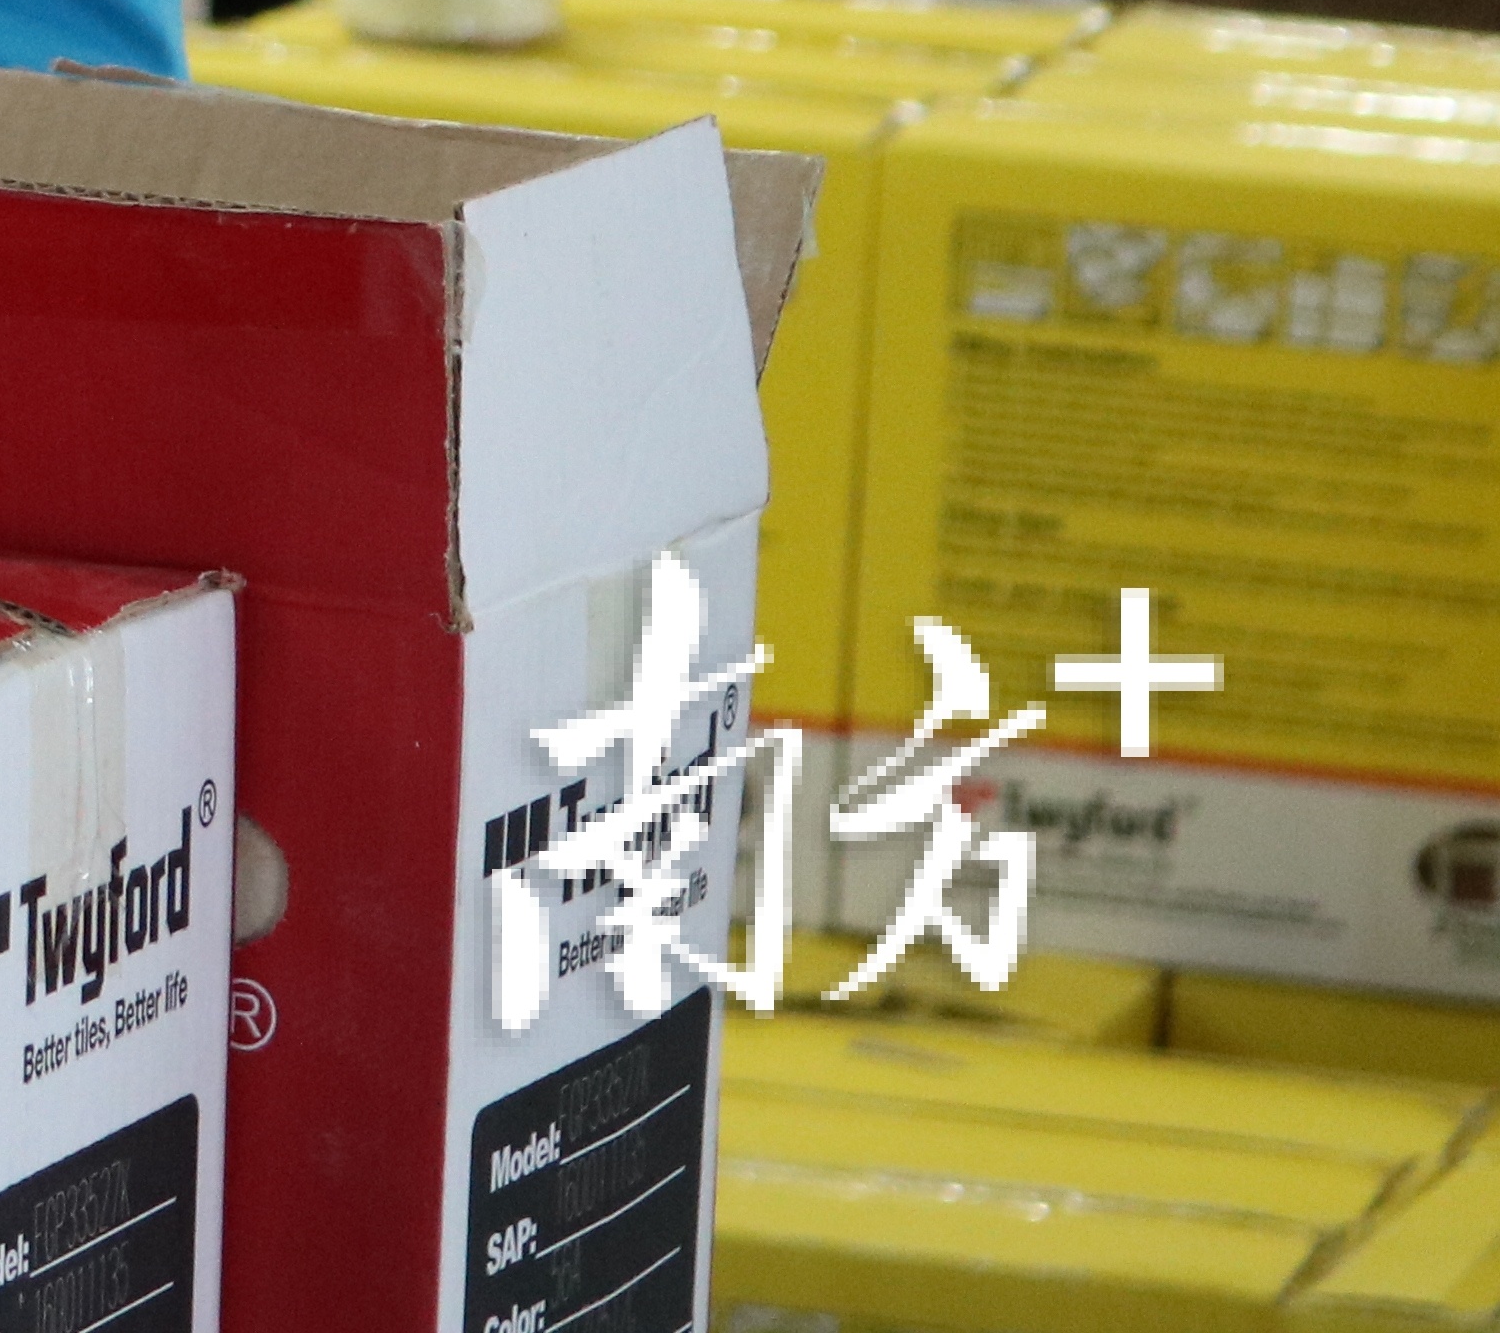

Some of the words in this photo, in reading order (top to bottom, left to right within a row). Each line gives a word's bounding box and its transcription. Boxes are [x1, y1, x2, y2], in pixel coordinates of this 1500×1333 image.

[23, 1034, 71, 1084] Better
[74, 1011, 112, 1058] tiles,
[114, 986, 161, 1040] Better
[164, 969, 189, 1013] life
[490, 1121, 562, 1194] Model:
[485, 1216, 537, 1276] SAP:
